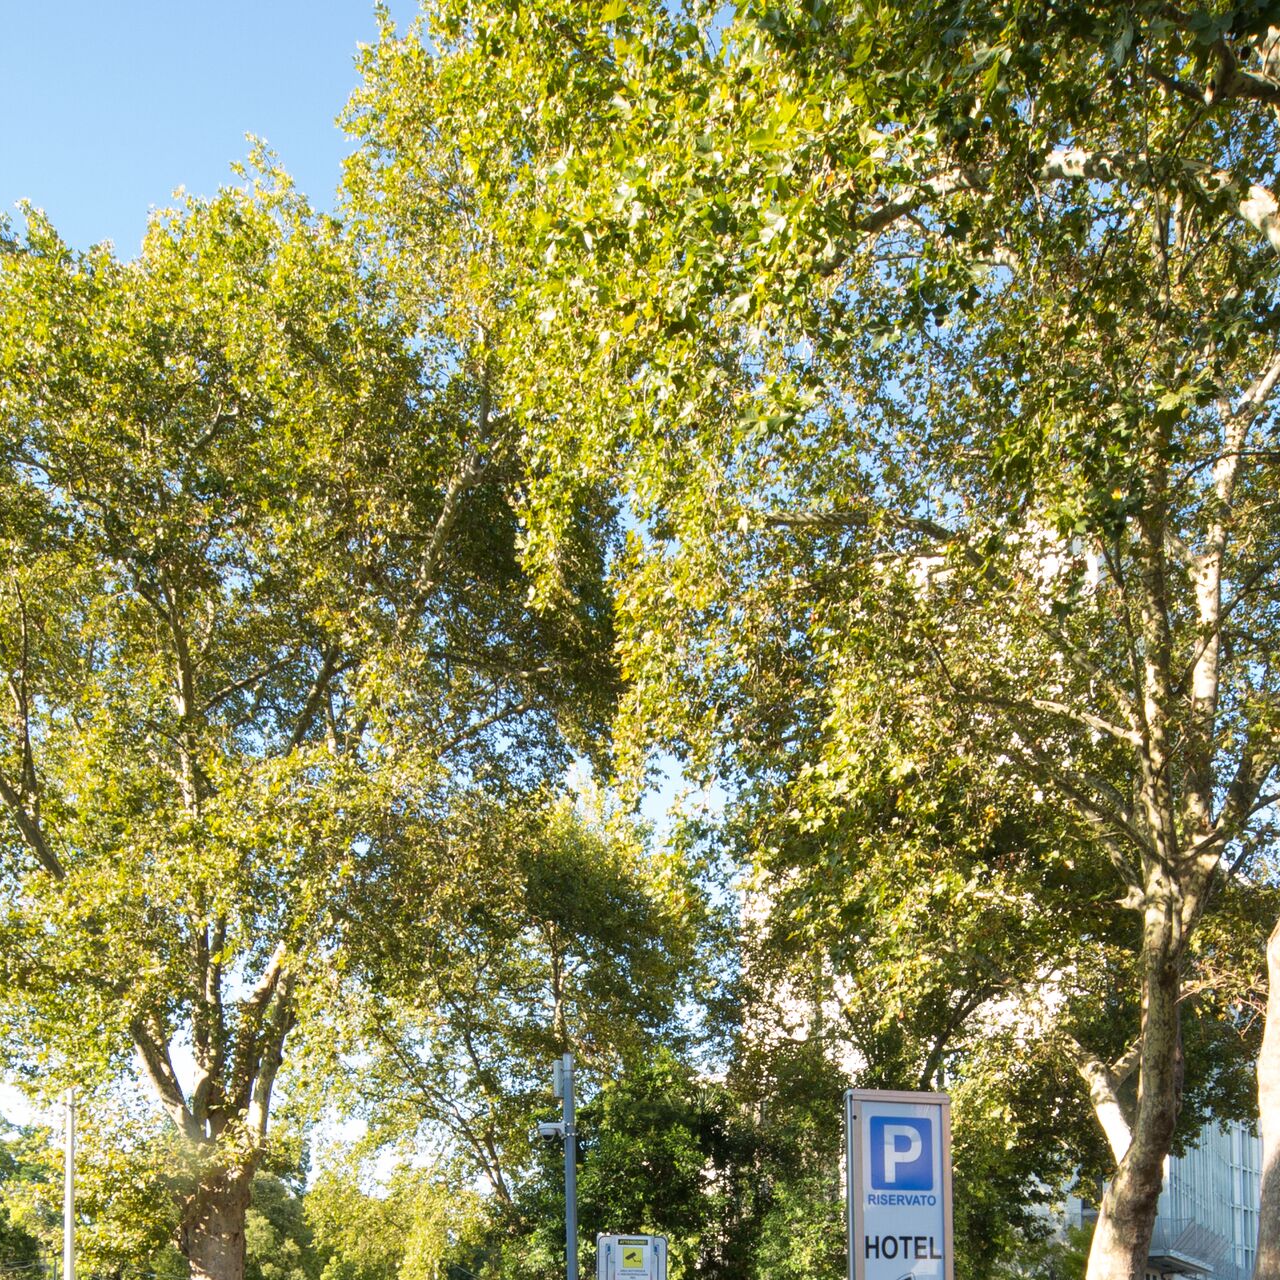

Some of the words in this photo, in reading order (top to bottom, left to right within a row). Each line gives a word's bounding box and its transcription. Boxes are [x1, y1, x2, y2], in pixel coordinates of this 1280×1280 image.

[883, 1124, 923, 1184] P
[868, 1194, 937, 1207] RISERVATO
[865, 1235, 943, 1260] HOTEL
